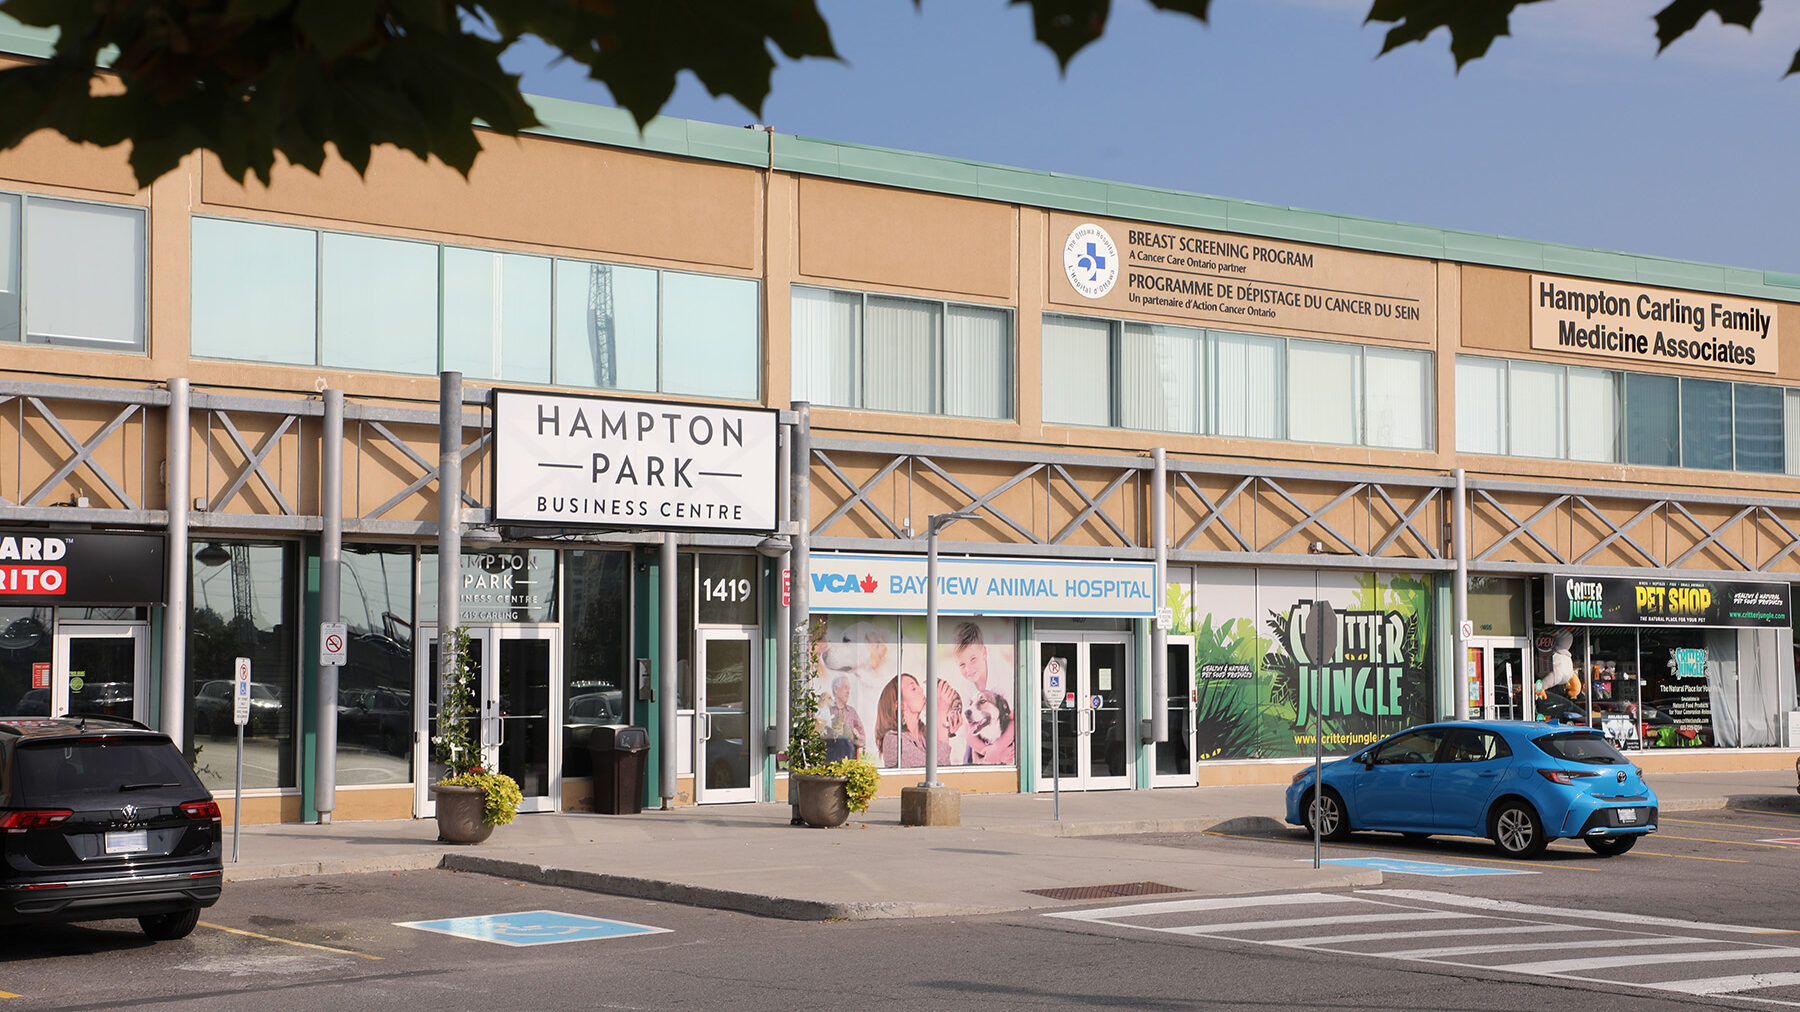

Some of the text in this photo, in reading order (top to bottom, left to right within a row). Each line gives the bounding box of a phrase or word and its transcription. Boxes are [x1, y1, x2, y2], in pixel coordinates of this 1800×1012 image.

[1128, 230, 1313, 268] BREAST SCREENING PROGRAM
[1129, 250, 1247, 274] A Cancer Care Ontario partner
[1128, 272, 1420, 321] PROGRAMME DE DÉPISTAGE DU CANCER DU SEIN
[1128, 292, 1276, 319] Un partenaire d'Action Cancer Ontario
[1539, 281, 1771, 339] Hampton Carling Family
[1558, 319, 1756, 366] Medicine Associates
[537, 404, 743, 448] HAMPTON
[592, 453, 693, 488] PARK
[537, 496, 742, 520] BUSINESS CENTRE
[0, 536, 67, 561] ARD
[463, 574, 513, 589] PARK
[703, 578, 751, 603] 1419
[811, 573, 861, 593] VCA
[890, 575, 979, 596] BAYIEW
[986, 577, 1059, 597] ANIMAL
[1065, 579, 1151, 598] HOSPITAL
[1566, 578, 1603, 601] CRITTER
[497, 595, 538, 604] CENTRE
[1569, 600, 1603, 621] JUNGLE
[1635, 586, 1712, 615] PET SHOP
[480, 611, 519, 620] CARLING
[1289, 604, 1405, 664] CITTER
[1536, 638, 1554, 647] OPEN
[1676, 647, 1704, 662] CRITTER
[1678, 662, 1704, 678] JUNGLE
[1295, 665, 1403, 727] JUNGLE
[1660, 684, 1668, 692] The
[1668, 684, 1684, 692] Natural
